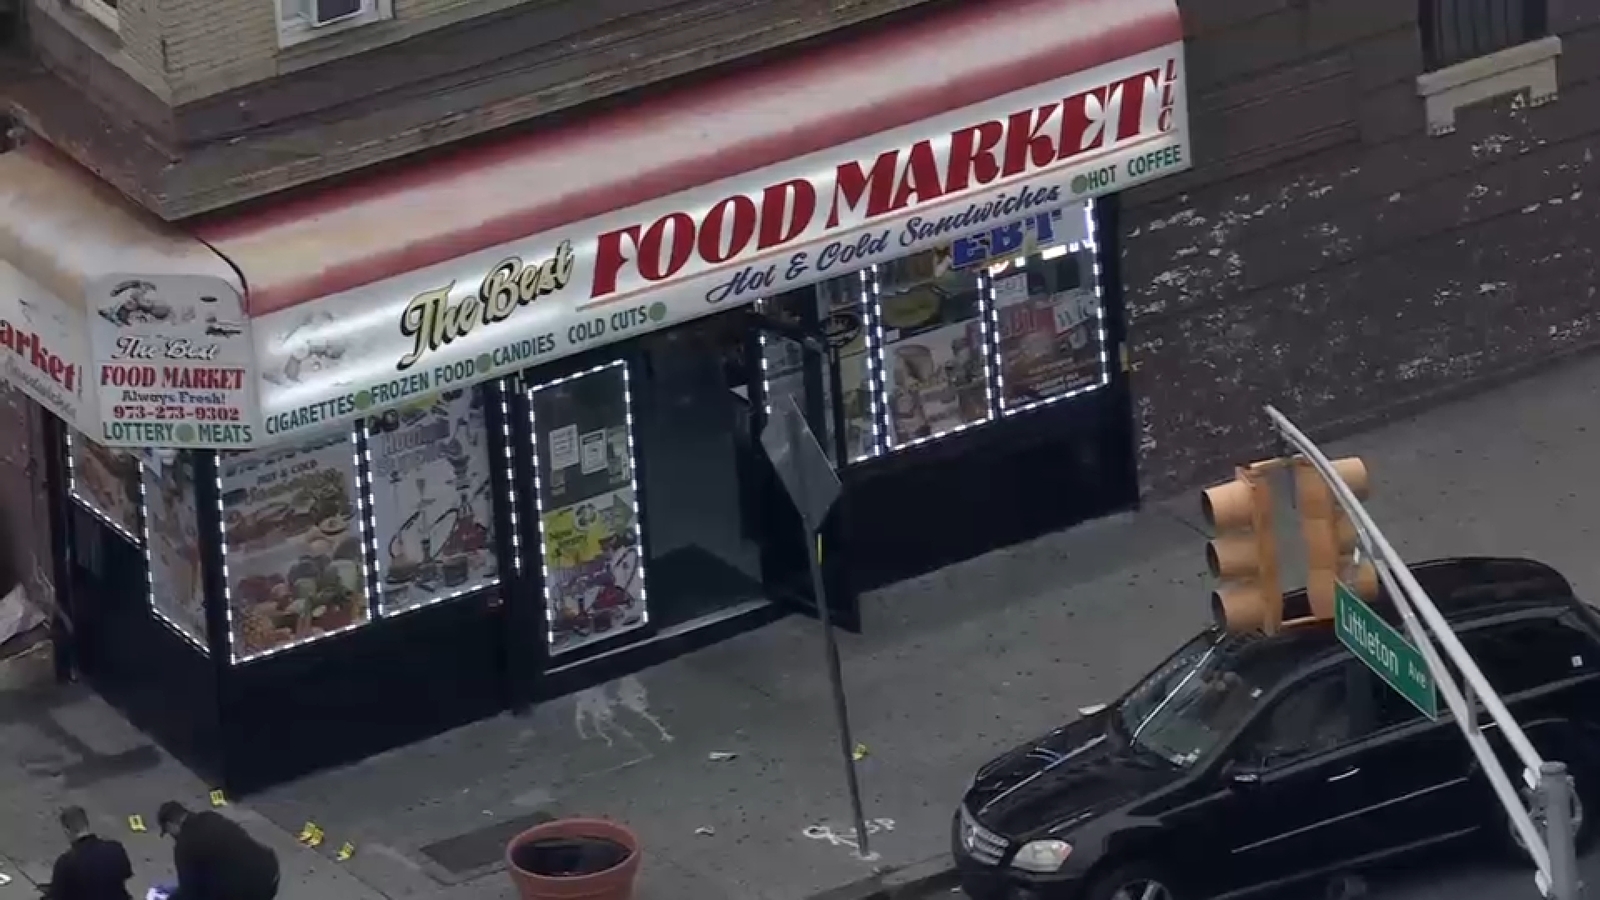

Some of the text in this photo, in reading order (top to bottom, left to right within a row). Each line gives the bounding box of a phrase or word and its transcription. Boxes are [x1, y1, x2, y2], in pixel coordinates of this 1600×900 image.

[1087, 144, 1182, 191] HOT COFFEE
[397, 68, 1161, 371] The Best FOOD MARKET
[705, 184, 1062, 304] Hot & Cold Sandwiches
[566, 307, 648, 346] COLD CUTS
[111, 336, 219, 361] The Best
[492, 333, 556, 367] CANDIES
[101, 364, 156, 388] FOOD
[161, 366, 246, 390] MARKET
[371, 358, 475, 405] FROZEN FOOD
[113, 405, 240, 421] 973-273-9302
[121, 389, 226, 406] Always Fresh!
[265, 385, 355, 435] CIGARETTES
[103, 422, 253, 443] LOTTERY MEATS
[1340, 597, 1427, 689] Littleton Ave
